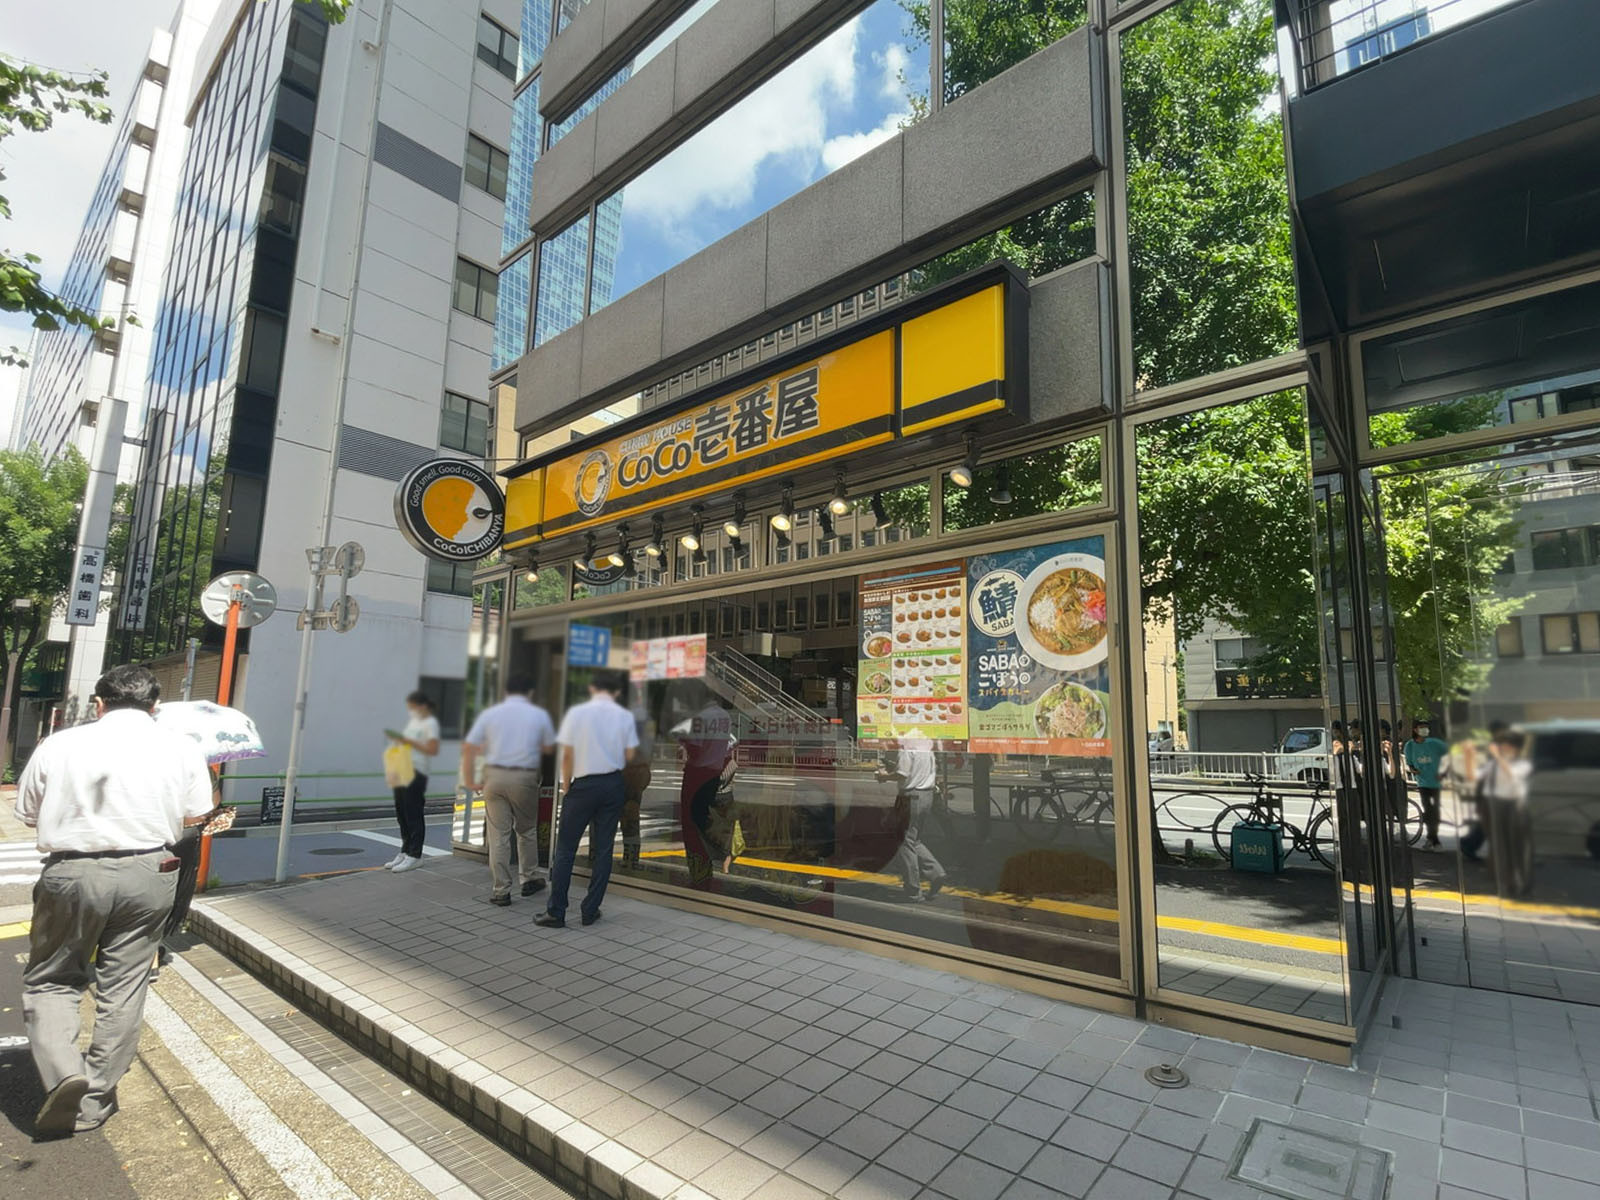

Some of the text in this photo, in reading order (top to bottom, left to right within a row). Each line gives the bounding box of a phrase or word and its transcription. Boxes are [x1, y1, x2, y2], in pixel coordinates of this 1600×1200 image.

[618, 365, 820, 488] CoCo壱番屋
[653, 417, 693, 442] HOUSE
[410, 484, 422, 507] Good
[438, 465, 461, 474] Good
[461, 469, 483, 482] curry
[433, 514, 504, 554] CoCoICHIBANYA
[74, 554, 98, 619] 高橋歯科
